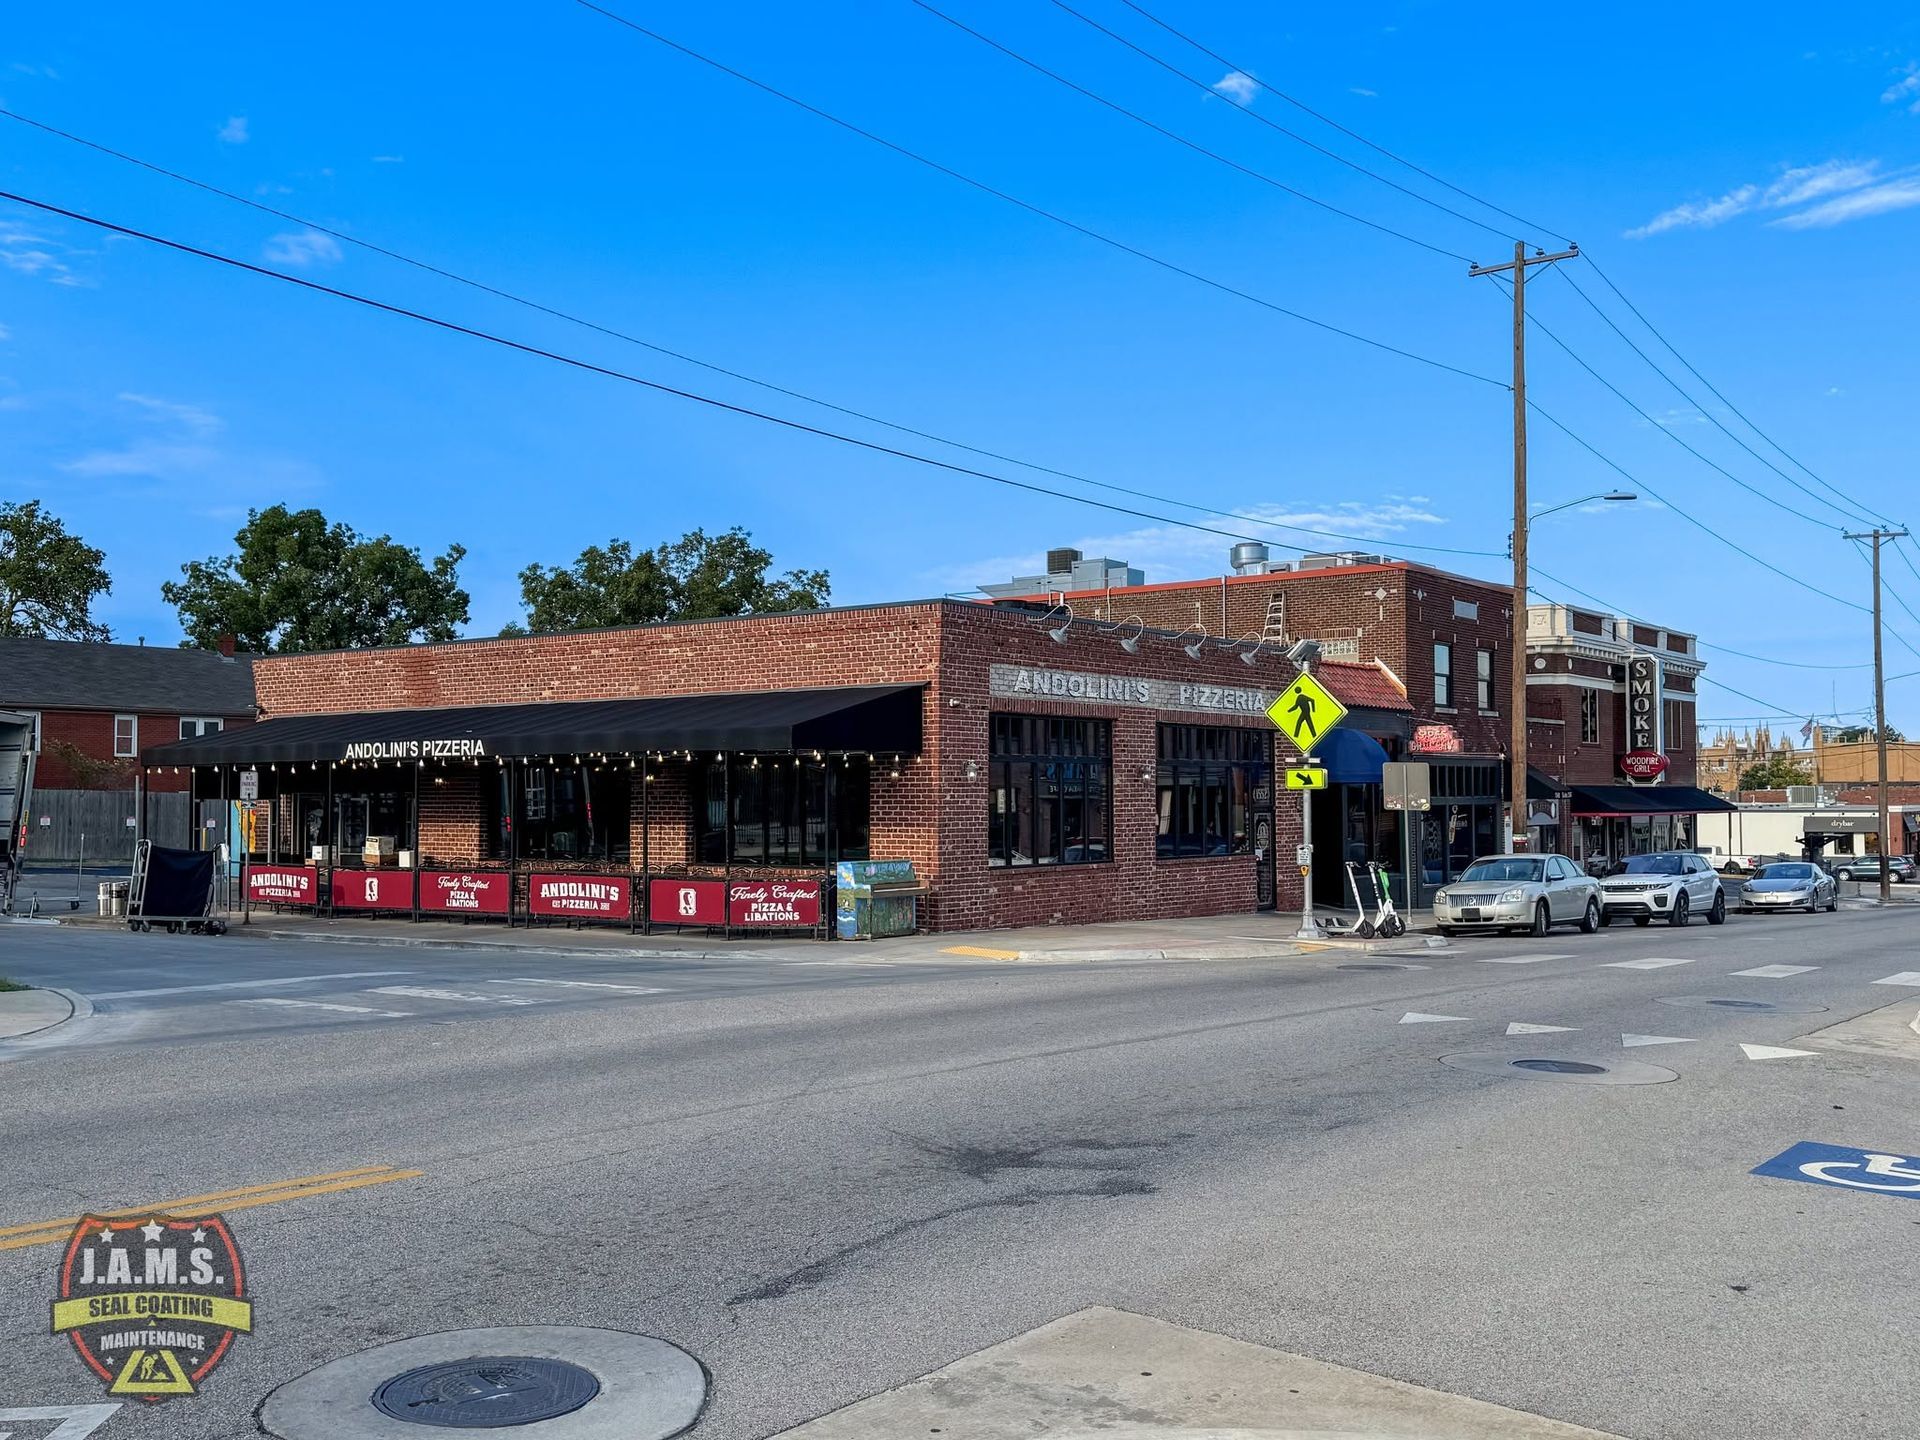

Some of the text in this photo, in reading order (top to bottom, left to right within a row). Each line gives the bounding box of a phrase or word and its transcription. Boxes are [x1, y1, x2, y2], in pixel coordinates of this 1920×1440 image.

[1013, 669, 1265, 711] ANDOLINI'S PIZZERIA
[345, 739, 485, 759] ANDOLINI'S PIZZERIA
[1625, 756, 1659, 765] WOODFIRE
[1633, 764, 1651, 773] GRILL
[1831, 819, 1855, 829] drybar
[250, 873, 309, 890] ANDOLINI'S
[437, 875, 490, 892] Finely Crafted
[265, 887, 292, 897] PIZZERIA
[450, 891, 469, 899] PIZZA
[540, 882, 620, 901] ANDOLINI'S
[730, 885, 818, 902] Finely Crafted
[446, 899, 479, 908] LIBATIONS
[561, 899, 599, 910] PIZZERIA
[751, 902, 793, 912] PIZZA &
[744, 911, 800, 921] LIBATIONS
